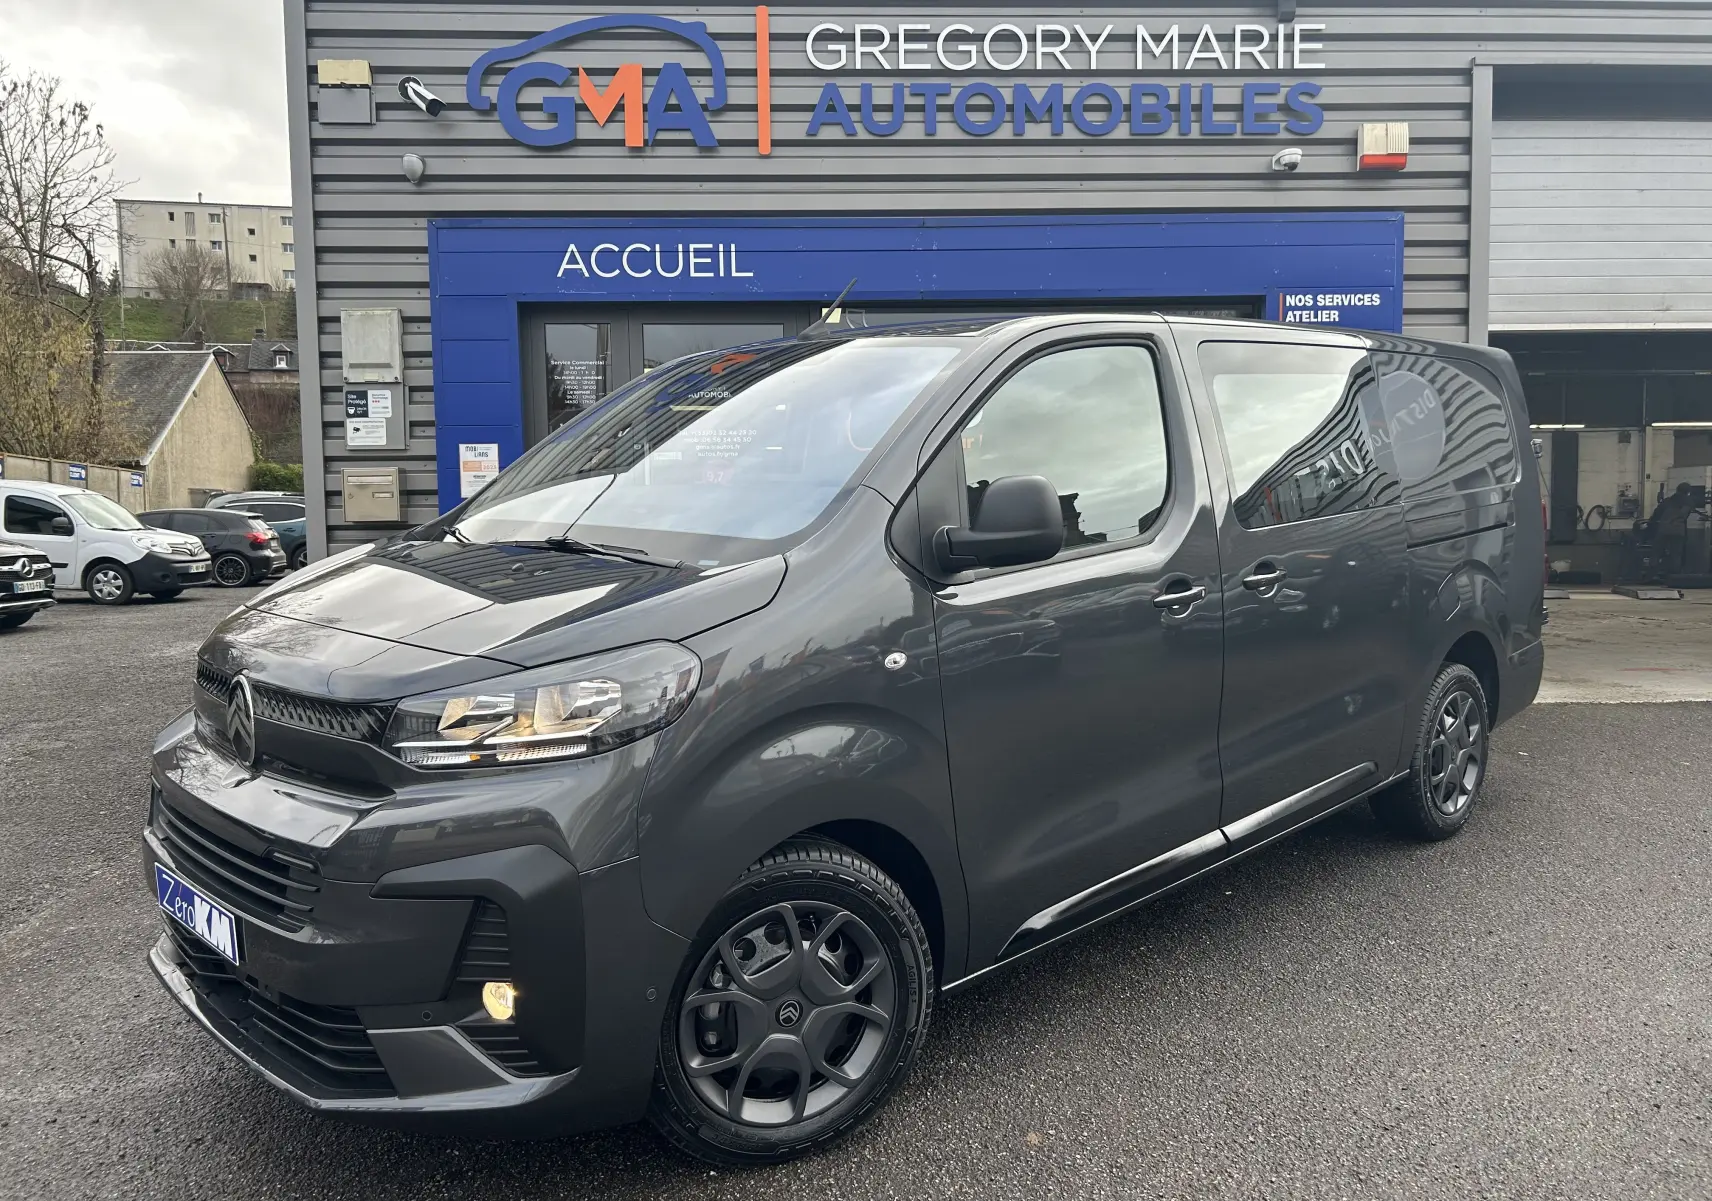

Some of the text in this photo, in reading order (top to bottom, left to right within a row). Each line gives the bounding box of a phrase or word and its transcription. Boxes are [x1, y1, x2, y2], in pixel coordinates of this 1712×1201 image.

[805, 23, 1326, 71] GREGORY MARIE
[497, 61, 720, 147] GMA
[805, 82, 1324, 136] AUTOMOBILES
[556, 243, 754, 278] ACCUEIL
[1285, 293, 1381, 307] NOS SERVICES
[1285, 310, 1339, 322] ATELIER
